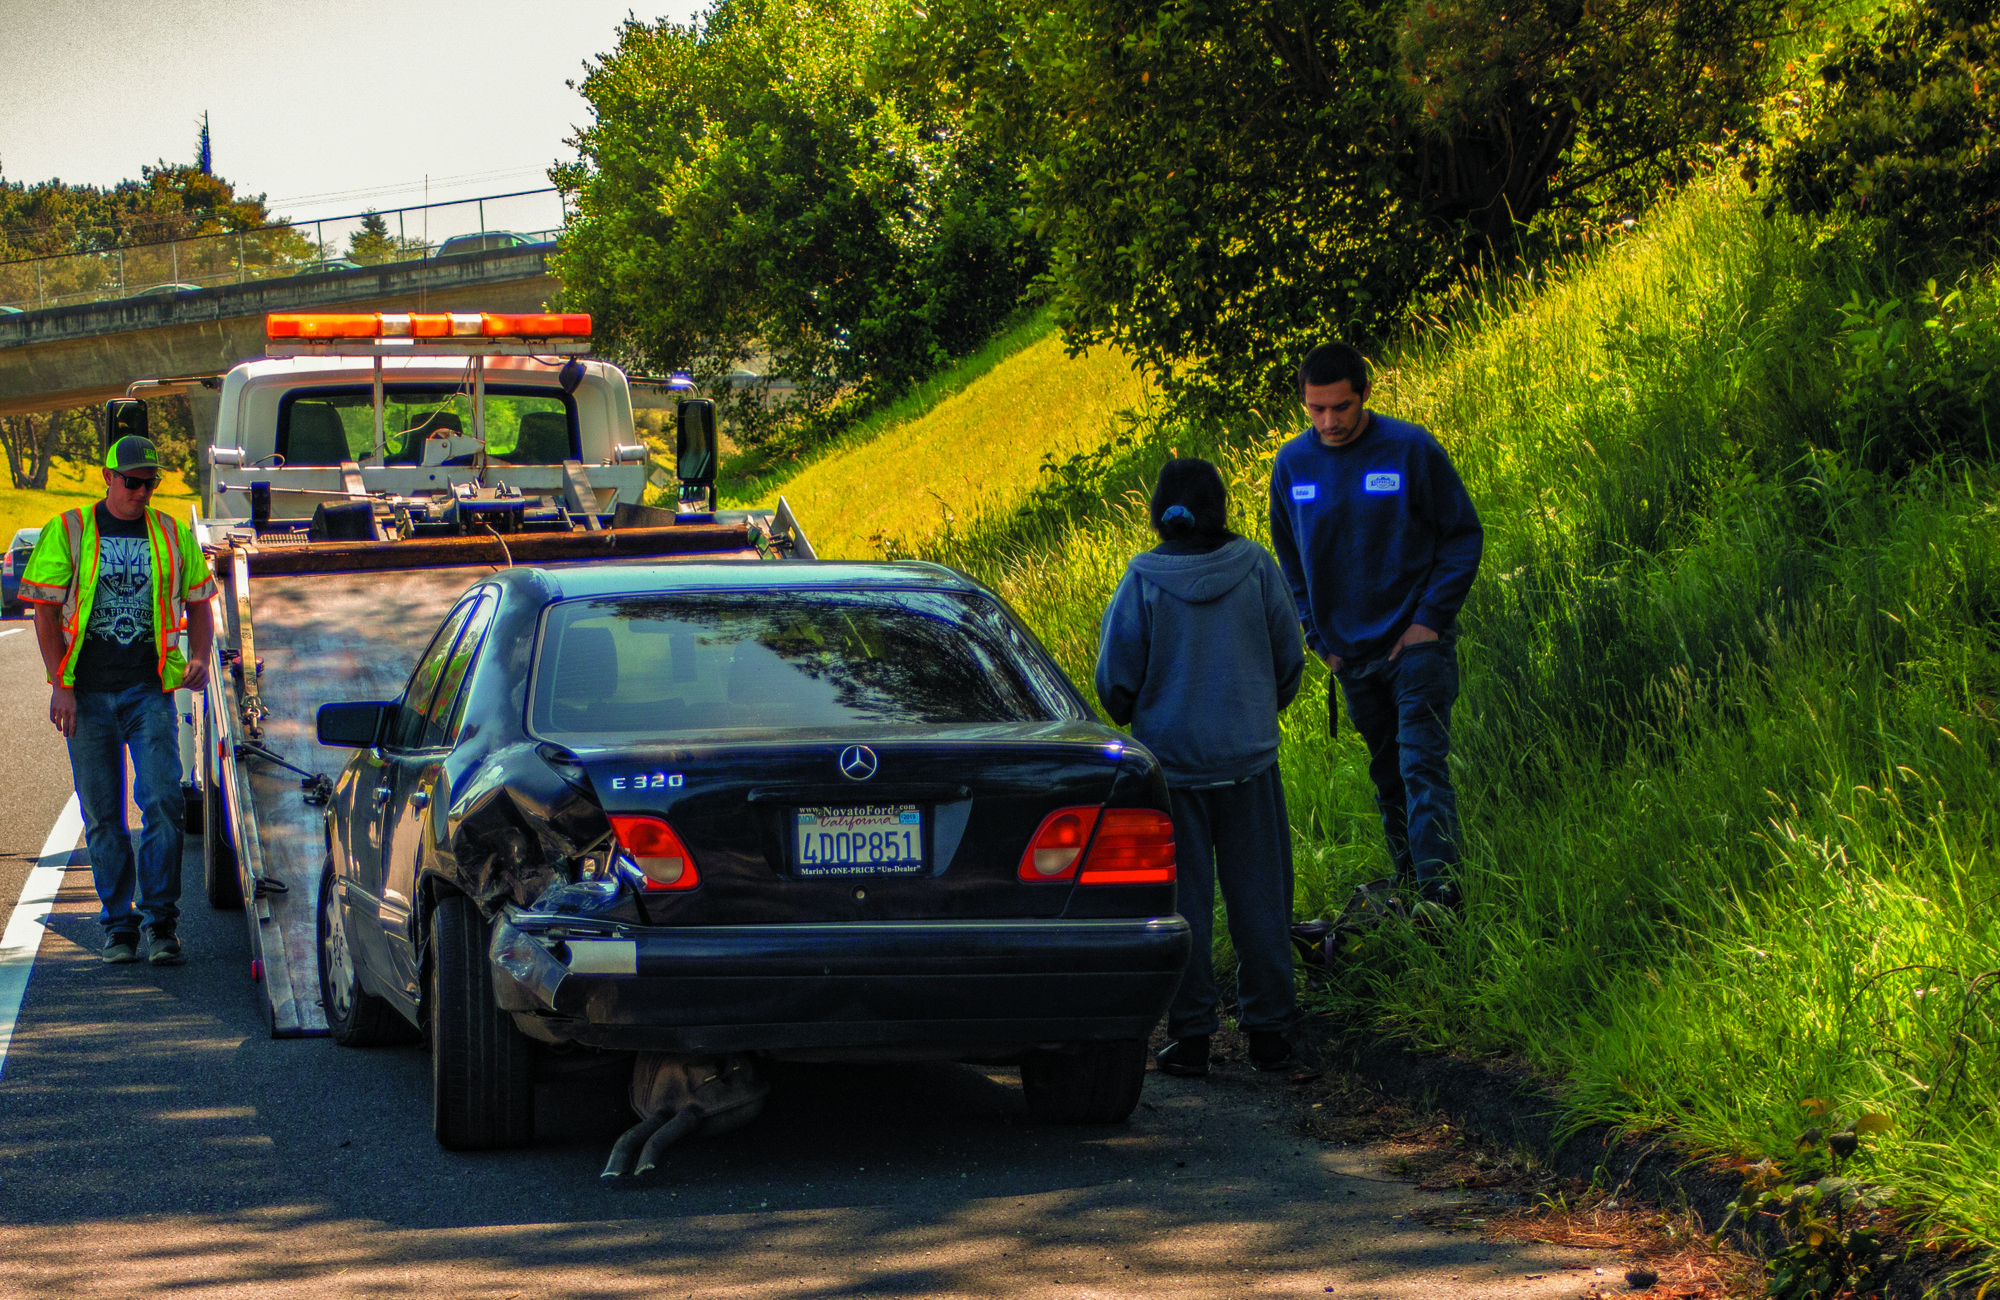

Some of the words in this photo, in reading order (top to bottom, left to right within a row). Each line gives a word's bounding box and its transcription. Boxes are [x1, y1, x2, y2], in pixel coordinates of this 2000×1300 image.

[90, 608, 107, 620] SAN
[110, 607, 153, 619] FRANCISC
[612, 777, 626, 789] E
[633, 774, 683, 788] 320
[820, 816, 900, 831] California
[803, 831, 917, 862] 4DOP851
[801, 867, 829, 875] Marin's
[830, 866, 875, 875] ONE-PRICE
